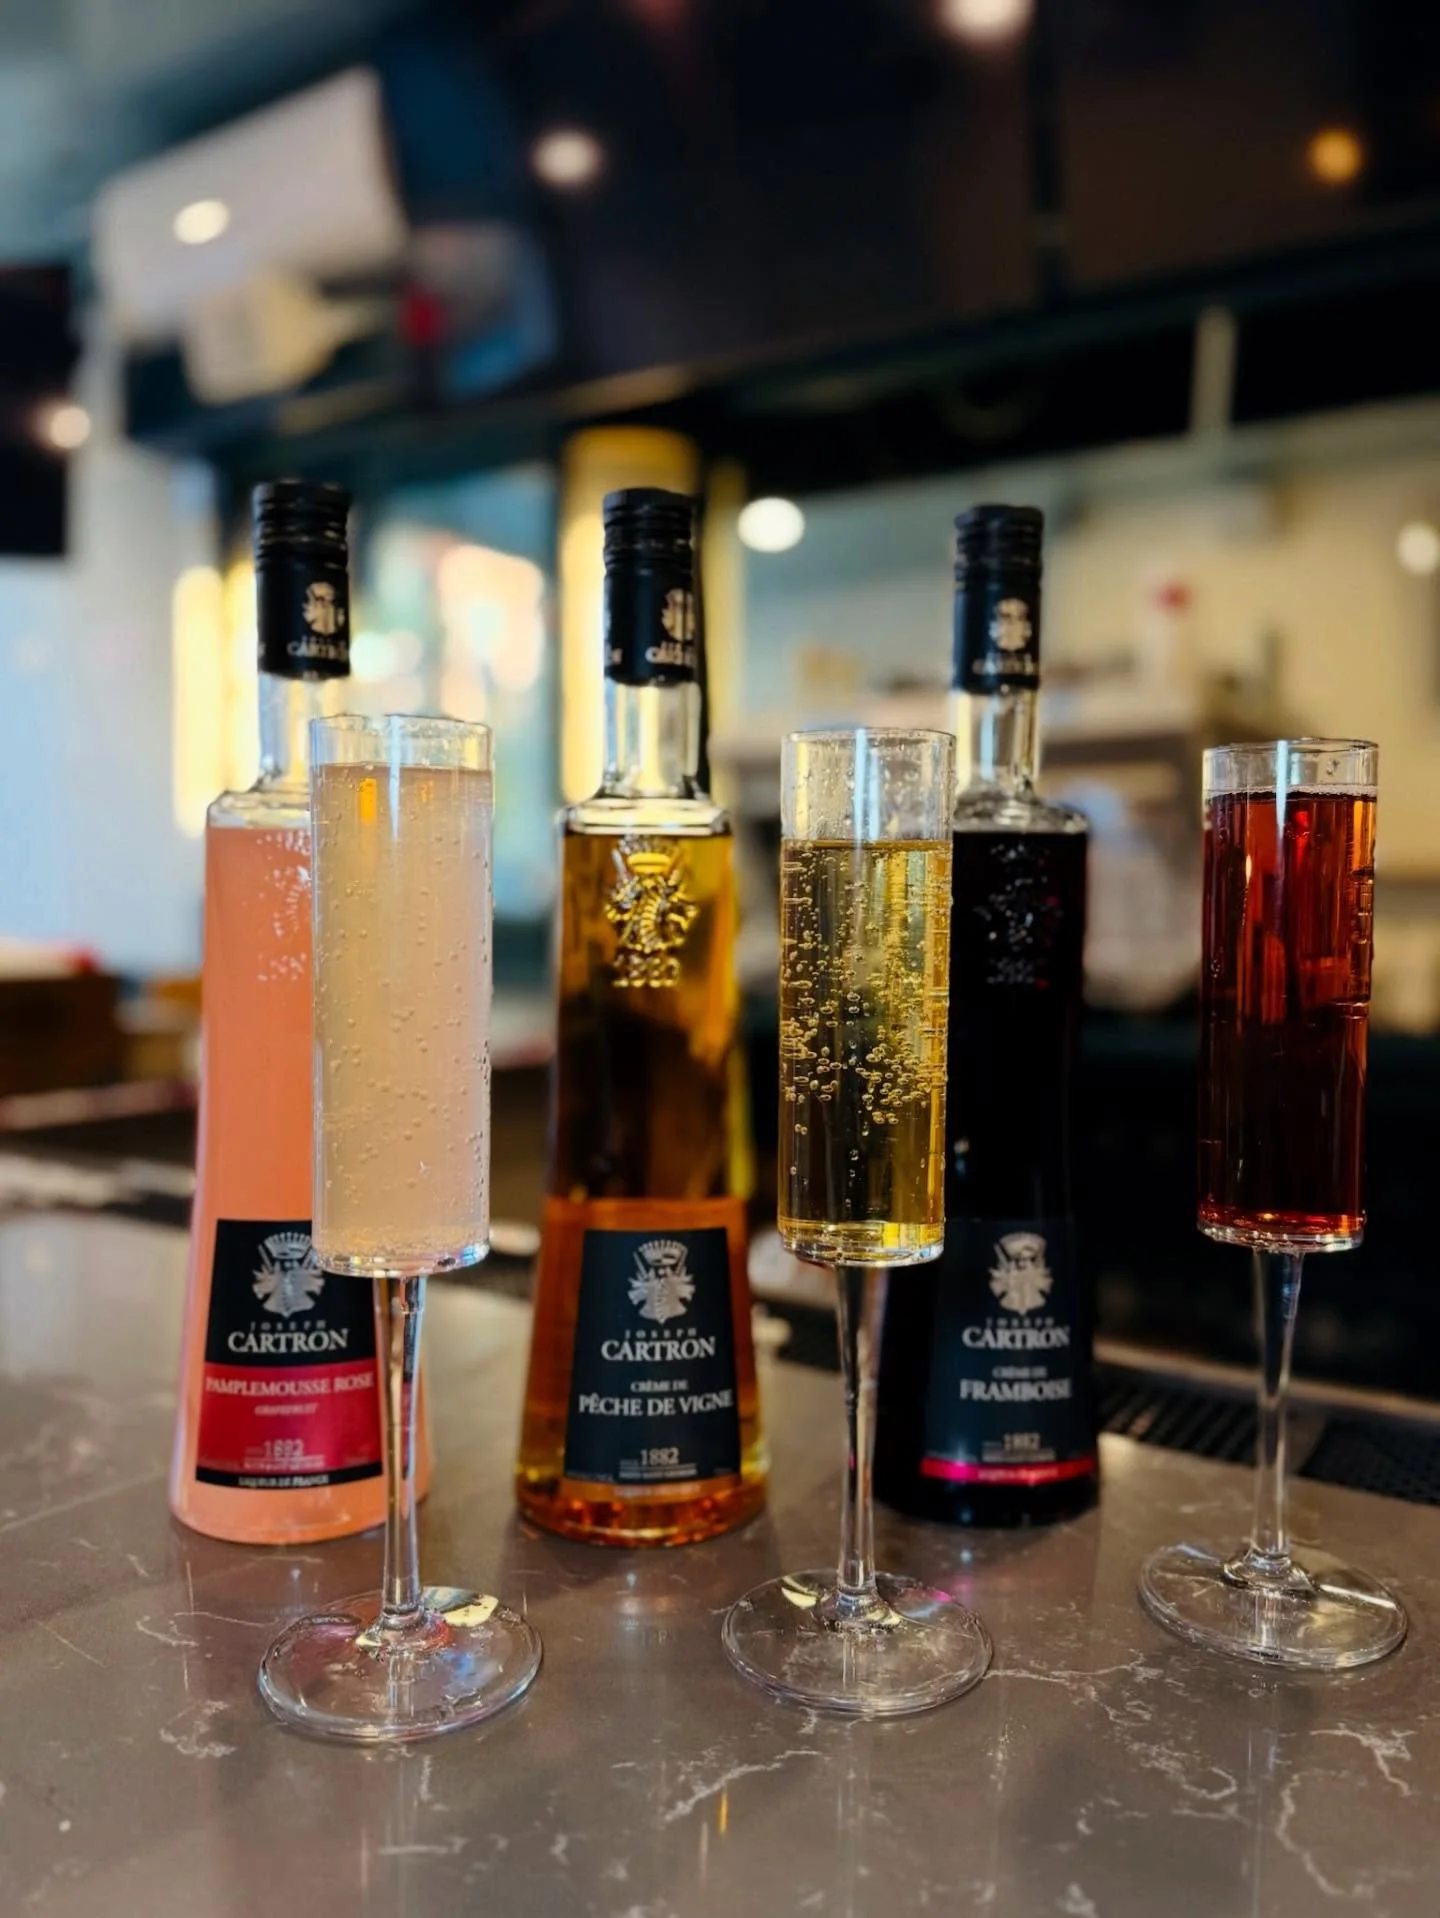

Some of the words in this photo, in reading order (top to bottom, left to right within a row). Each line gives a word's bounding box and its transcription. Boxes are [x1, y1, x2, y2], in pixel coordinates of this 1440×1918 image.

[227, 1328, 349, 1353] CARTRON
[625, 1328, 697, 1339] JOSEPH
[961, 1326, 1070, 1349] CARTRON
[601, 1336, 716, 1361] CARTRON
[206, 1376, 331, 1396] PAMPLEMOUSSE
[333, 1372, 374, 1392] ROSE
[673, 1379, 688, 1392] DE
[578, 1392, 643, 1416] PÊCHE
[647, 1398, 676, 1416] DE
[679, 1389, 734, 1414] VIGNE
[641, 1447, 679, 1466] 1882
